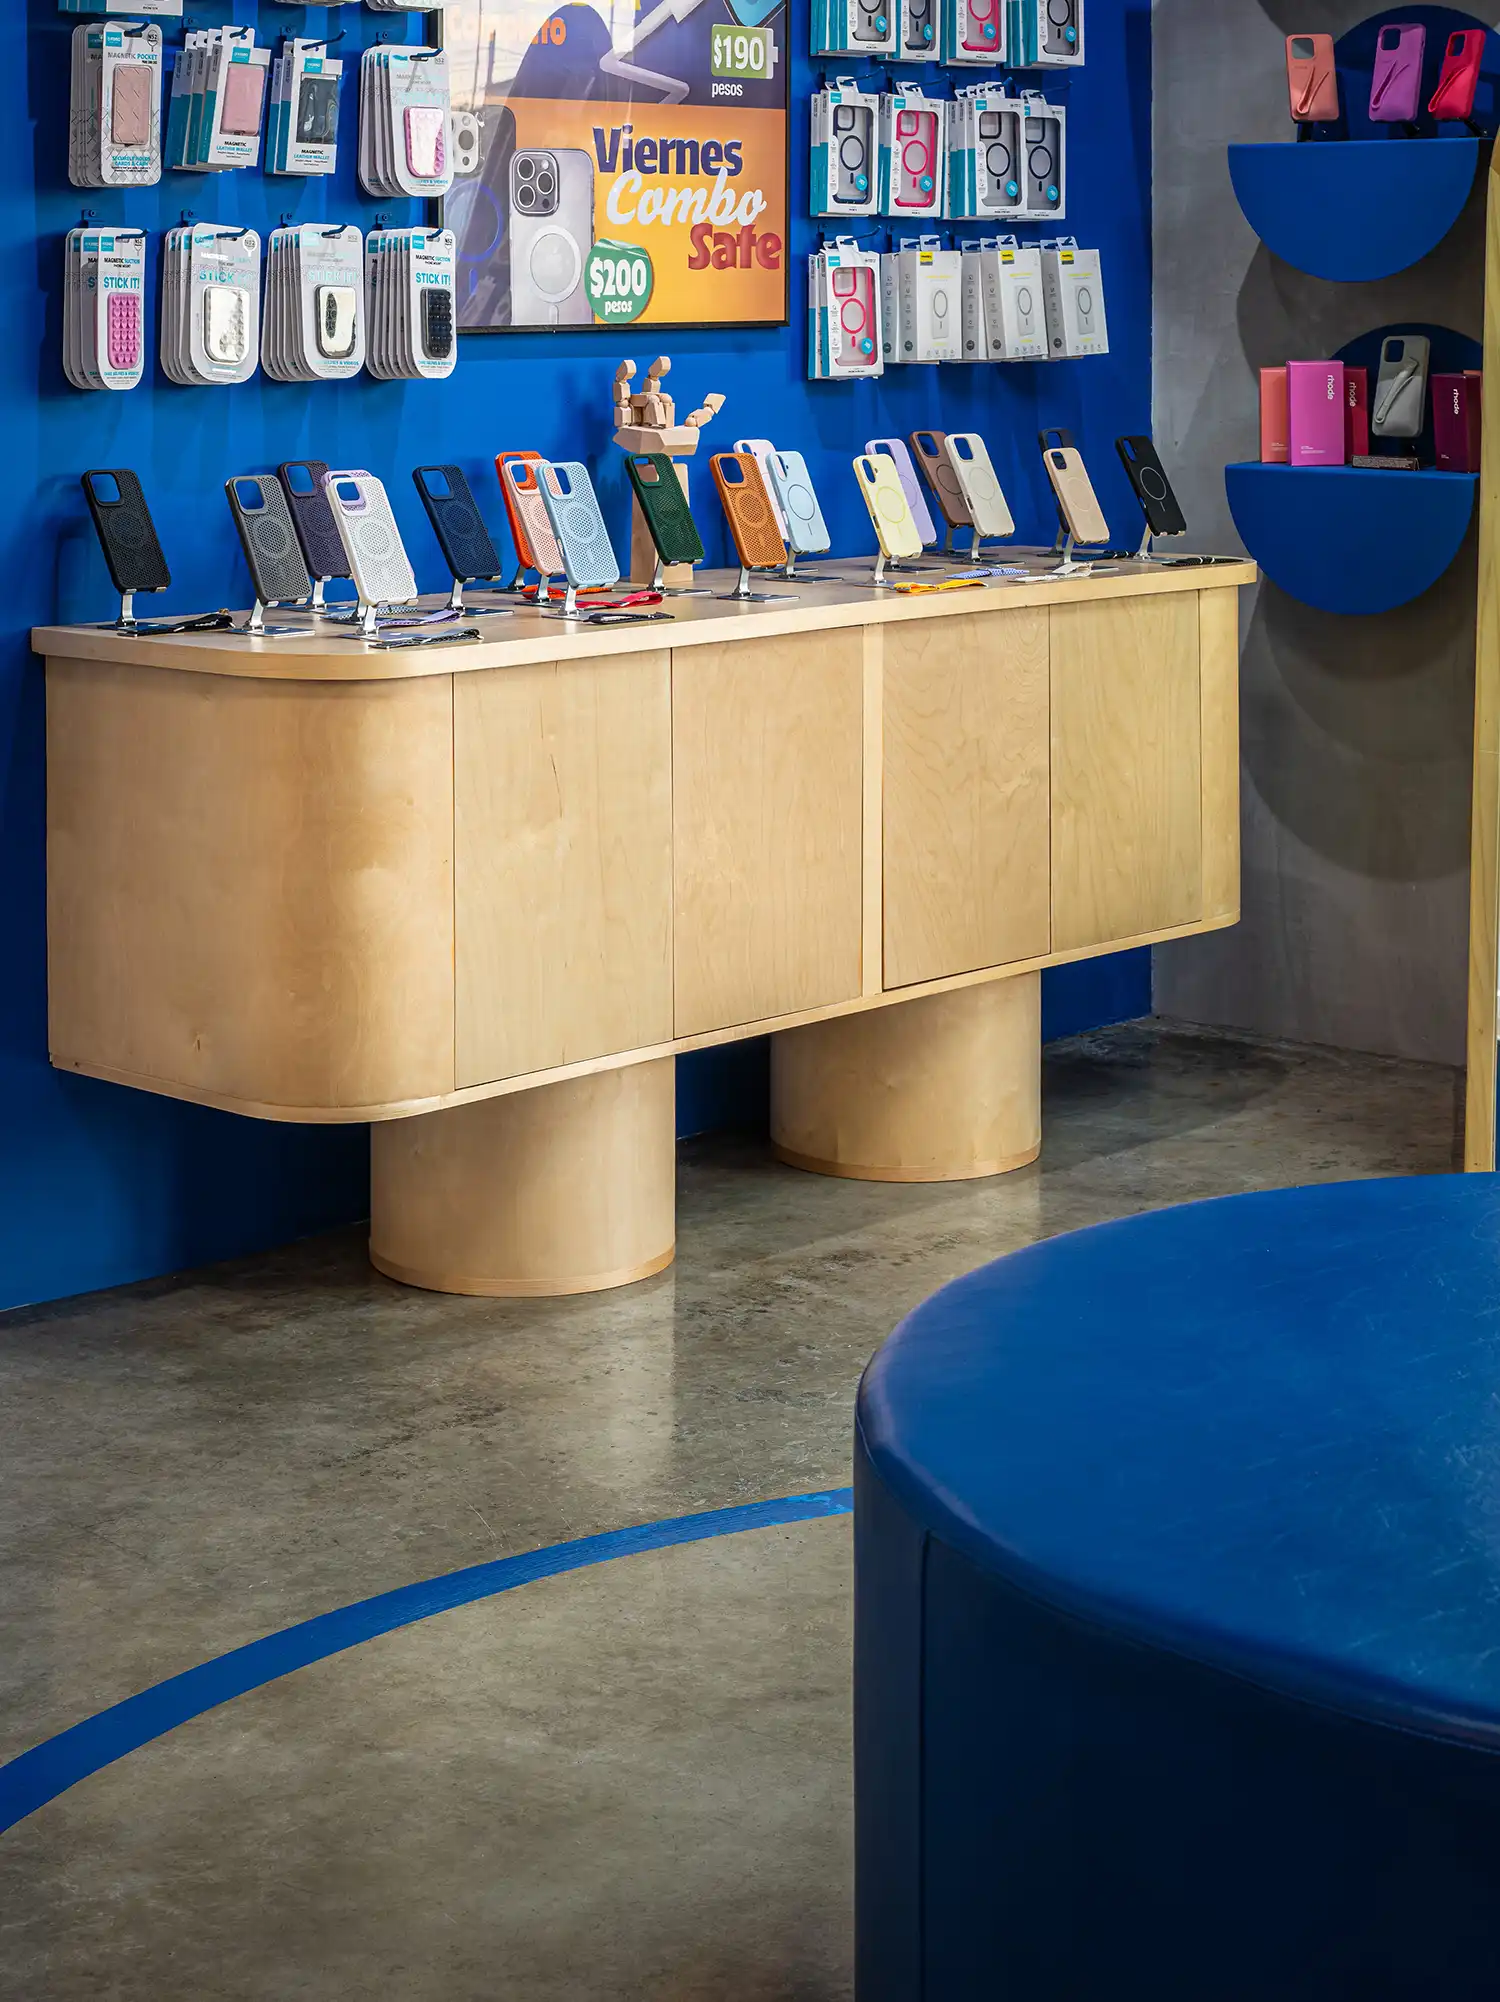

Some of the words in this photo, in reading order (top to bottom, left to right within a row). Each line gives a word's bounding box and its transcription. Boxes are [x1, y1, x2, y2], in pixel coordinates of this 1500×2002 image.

[713, 33, 764, 71] $190
[711, 82, 743, 97] pesos
[592, 124, 743, 176] Viernes
[606, 166, 768, 227] Combo
[688, 222, 782, 271] Safe
[103, 276, 129, 289] STICK
[130, 277, 140, 289] IT!
[199, 270, 235, 283] STICK
[308, 270, 340, 282] STICK
[415, 272, 440, 285] STICK
[441, 274, 451, 286] IT!
[589, 256, 647, 299] $200
[605, 299, 633, 315] pesos
[1327, 374, 1335, 400] rhode
[1349, 382, 1357, 407] rhode
